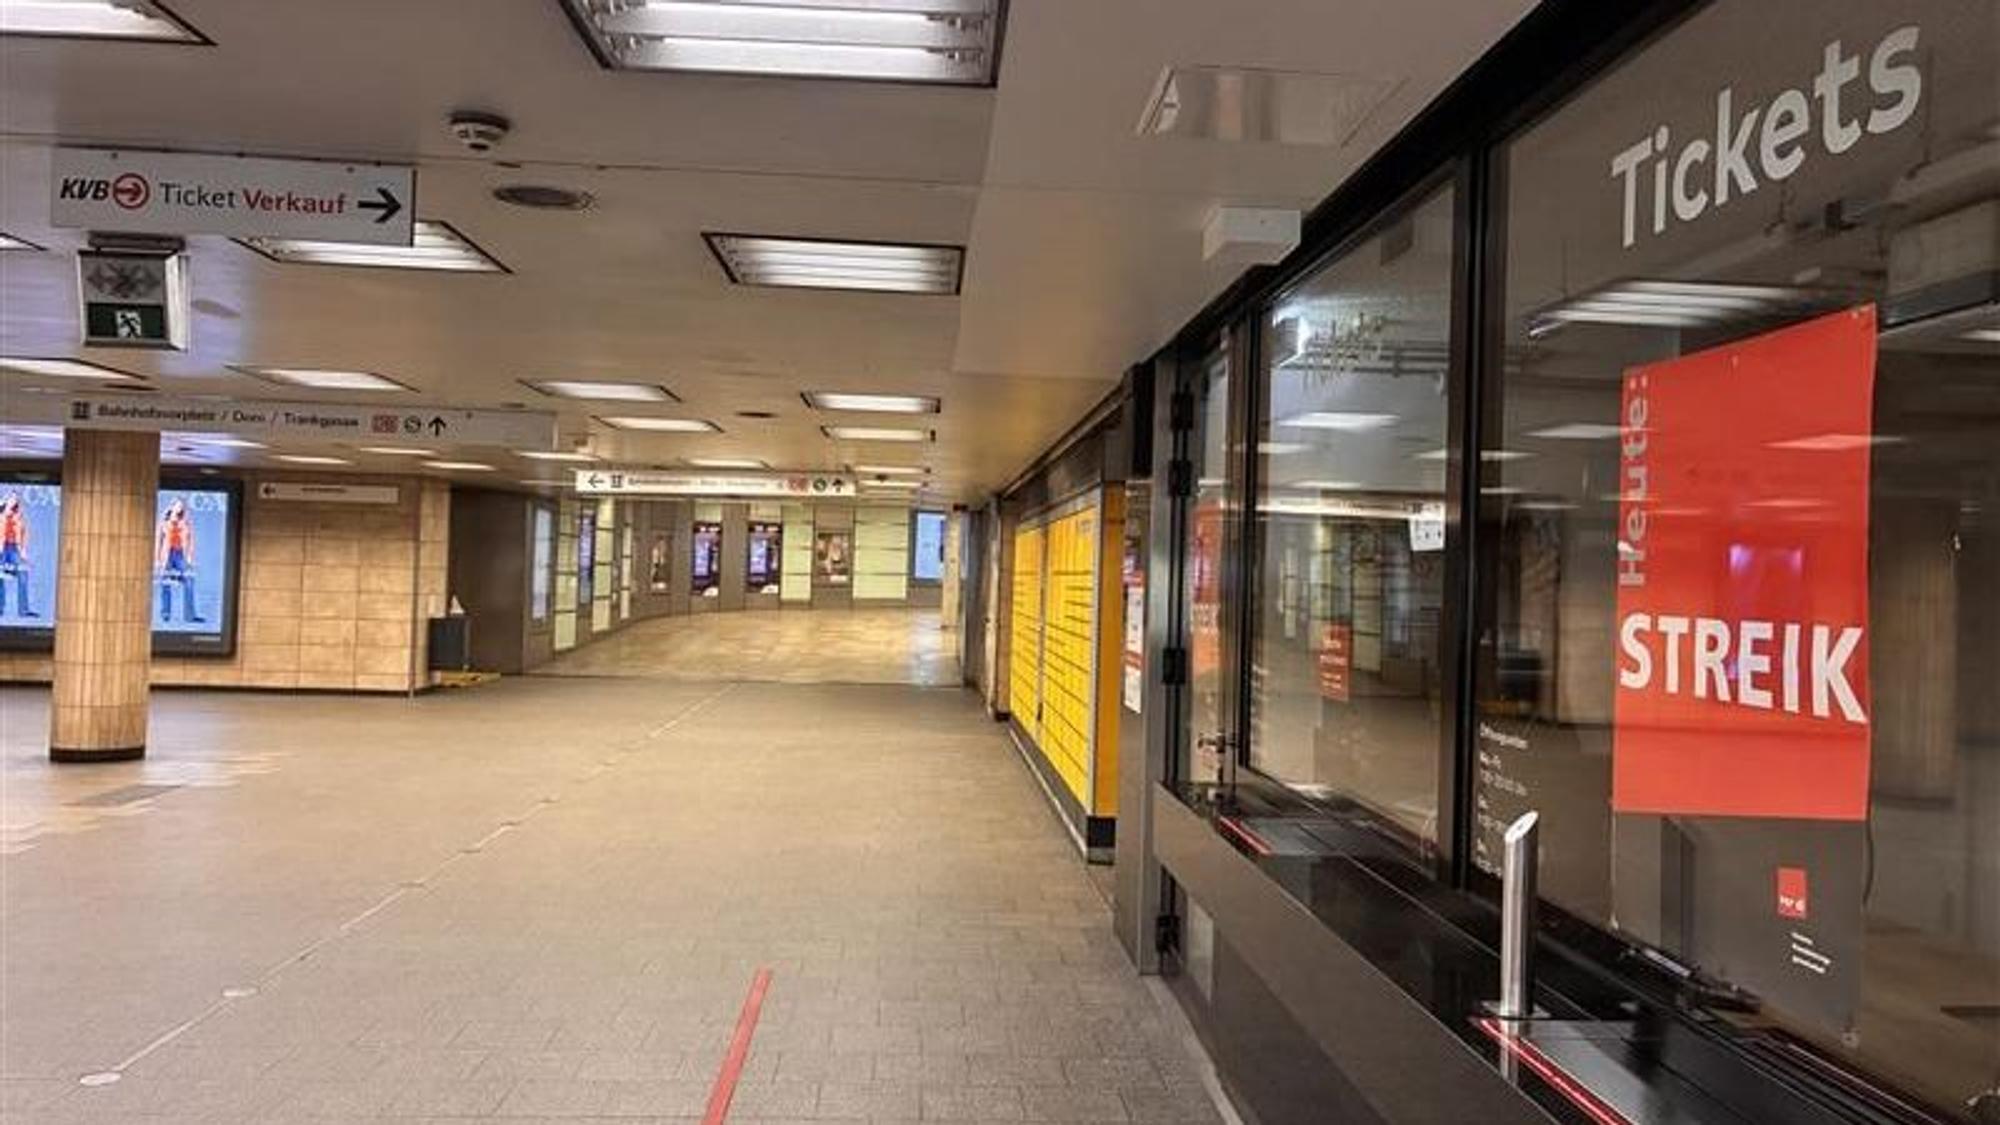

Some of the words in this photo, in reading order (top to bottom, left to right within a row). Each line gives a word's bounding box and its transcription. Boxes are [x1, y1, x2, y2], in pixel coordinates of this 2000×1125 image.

[1611, 26, 1922, 248] Tickets
[60, 178, 109, 200] KVB
[160, 183, 236, 209] Ticket
[242, 188, 345, 214] Verkauf
[233, 411, 265, 423] Dom
[1618, 375, 1648, 587] Heute:
[1619, 612, 1868, 724] STREIK
